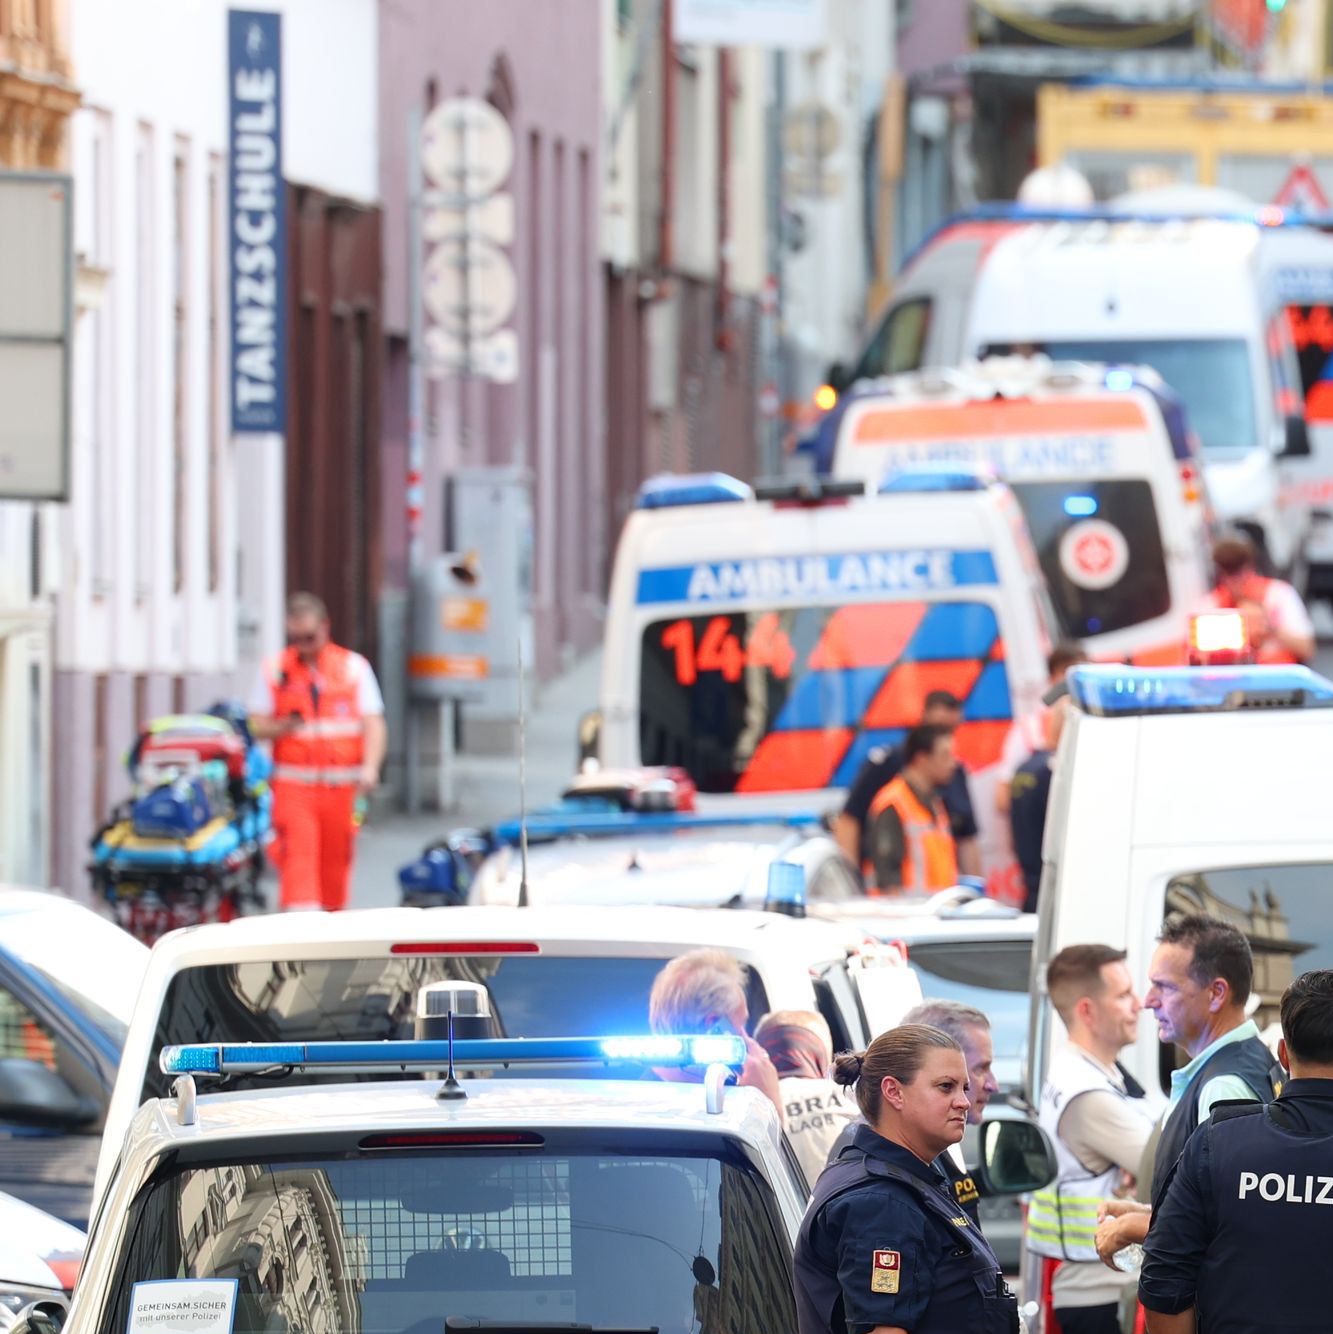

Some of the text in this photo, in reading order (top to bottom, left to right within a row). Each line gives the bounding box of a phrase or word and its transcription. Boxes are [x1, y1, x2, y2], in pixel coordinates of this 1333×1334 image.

[235, 67, 276, 410] TANZSCHULE
[687, 550, 956, 600] AMBULANCE
[660, 612, 796, 686] 144
[137, 1302, 227, 1312] GEMEINSAM.SICHER
[192, 1312, 221, 1320] Polizei
